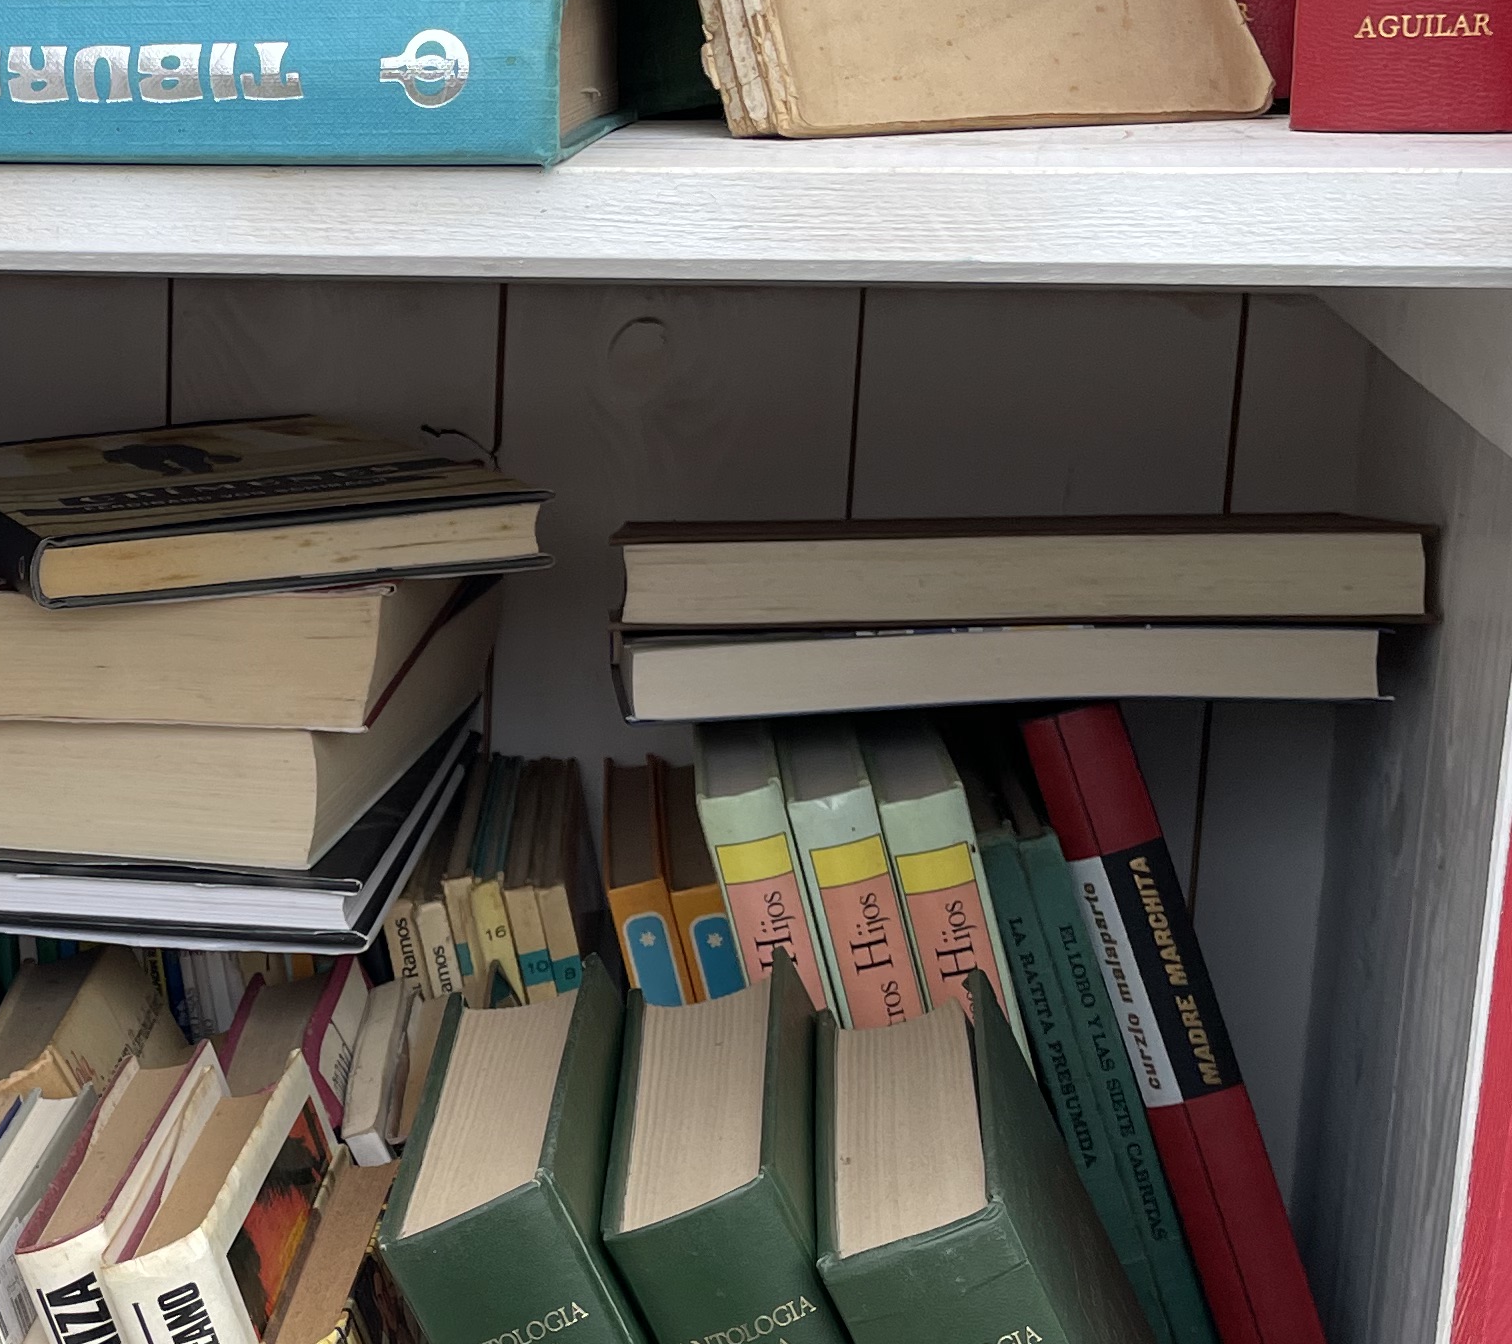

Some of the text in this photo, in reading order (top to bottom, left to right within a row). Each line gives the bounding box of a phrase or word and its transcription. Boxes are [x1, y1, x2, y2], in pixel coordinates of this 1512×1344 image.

[1354, 13, 1493, 39] AGUILAR
[396, 917, 419, 980] Ramos
[486, 925, 507, 941] 16
[528, 960, 548, 974] 10
[848, 890, 896, 976] Hijos
[1083, 882, 1162, 1090] curzio malaparte
[1128, 856, 1223, 1087] MADRE MARCHITA
[1058, 924, 1168, 1243] EL LOBO LAS SIETE CABRITAS
